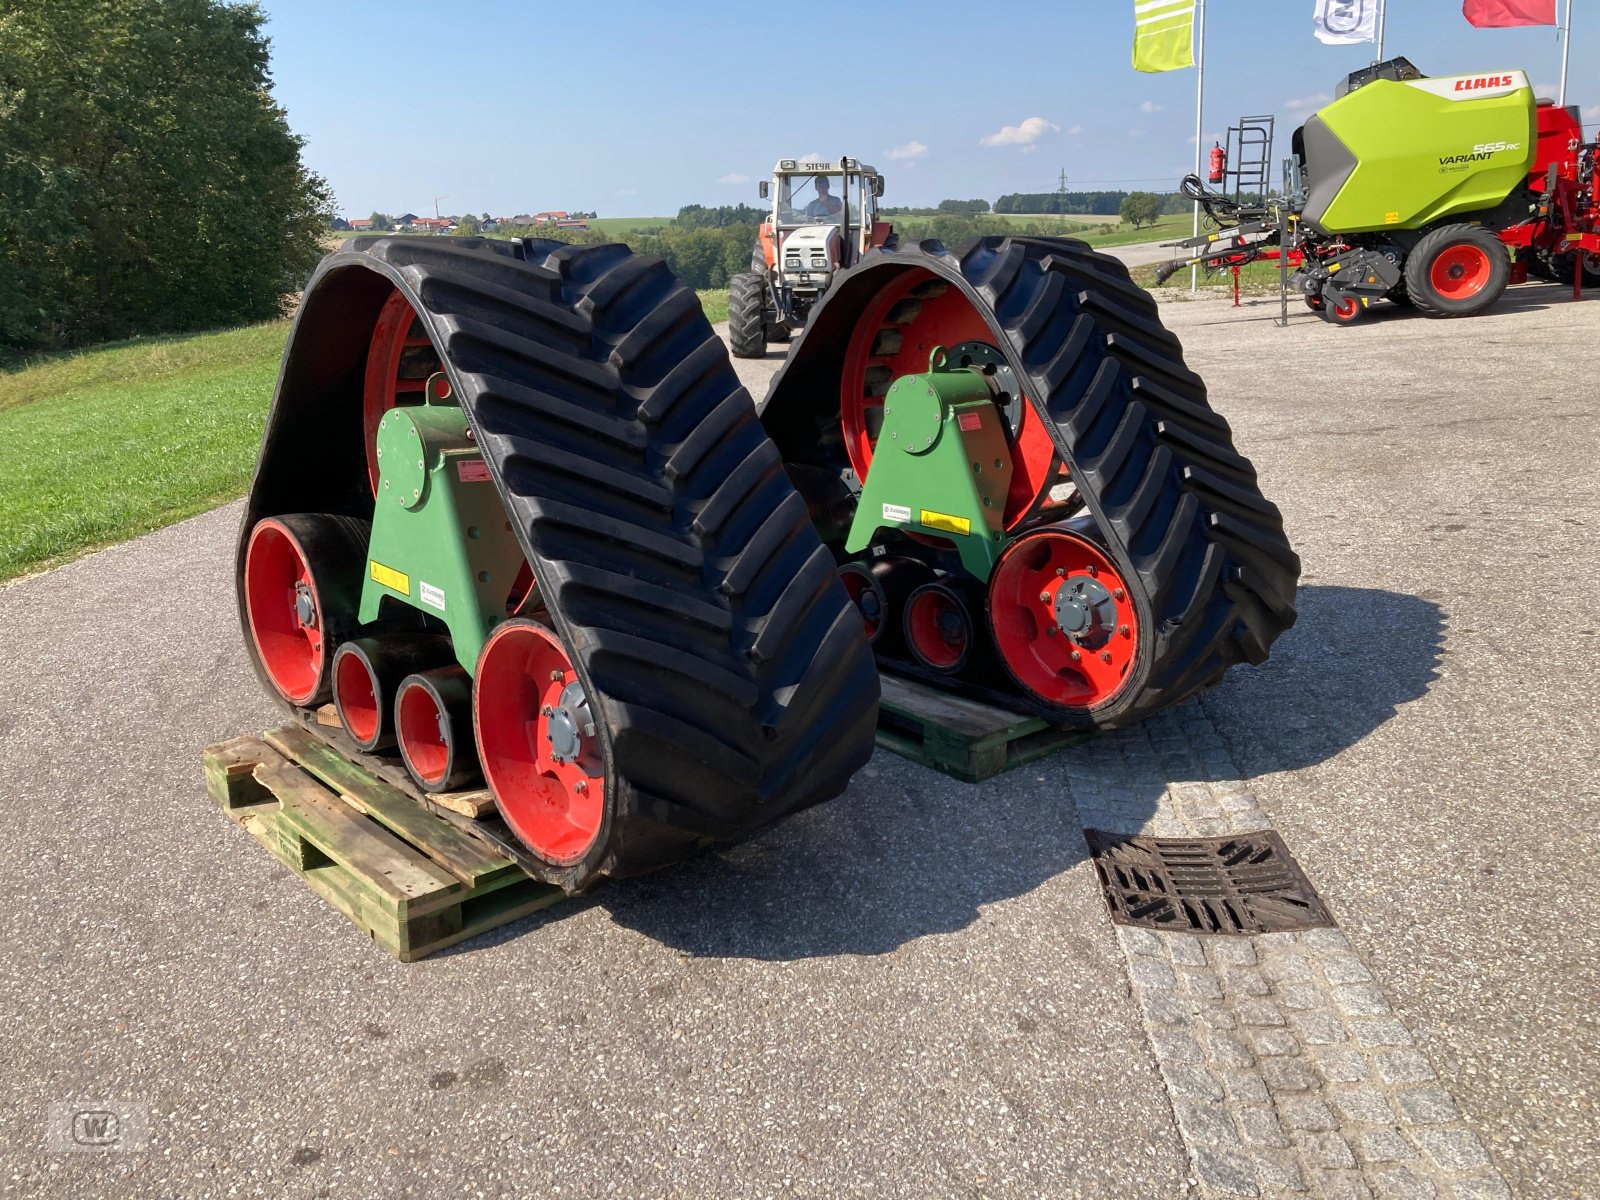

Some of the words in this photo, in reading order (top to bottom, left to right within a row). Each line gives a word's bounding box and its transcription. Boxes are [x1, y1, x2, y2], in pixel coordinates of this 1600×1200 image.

[1455, 75, 1512, 91] CLAAS
[1473, 142, 1506, 154] 565
[1439, 152, 1494, 165] VARIANT
